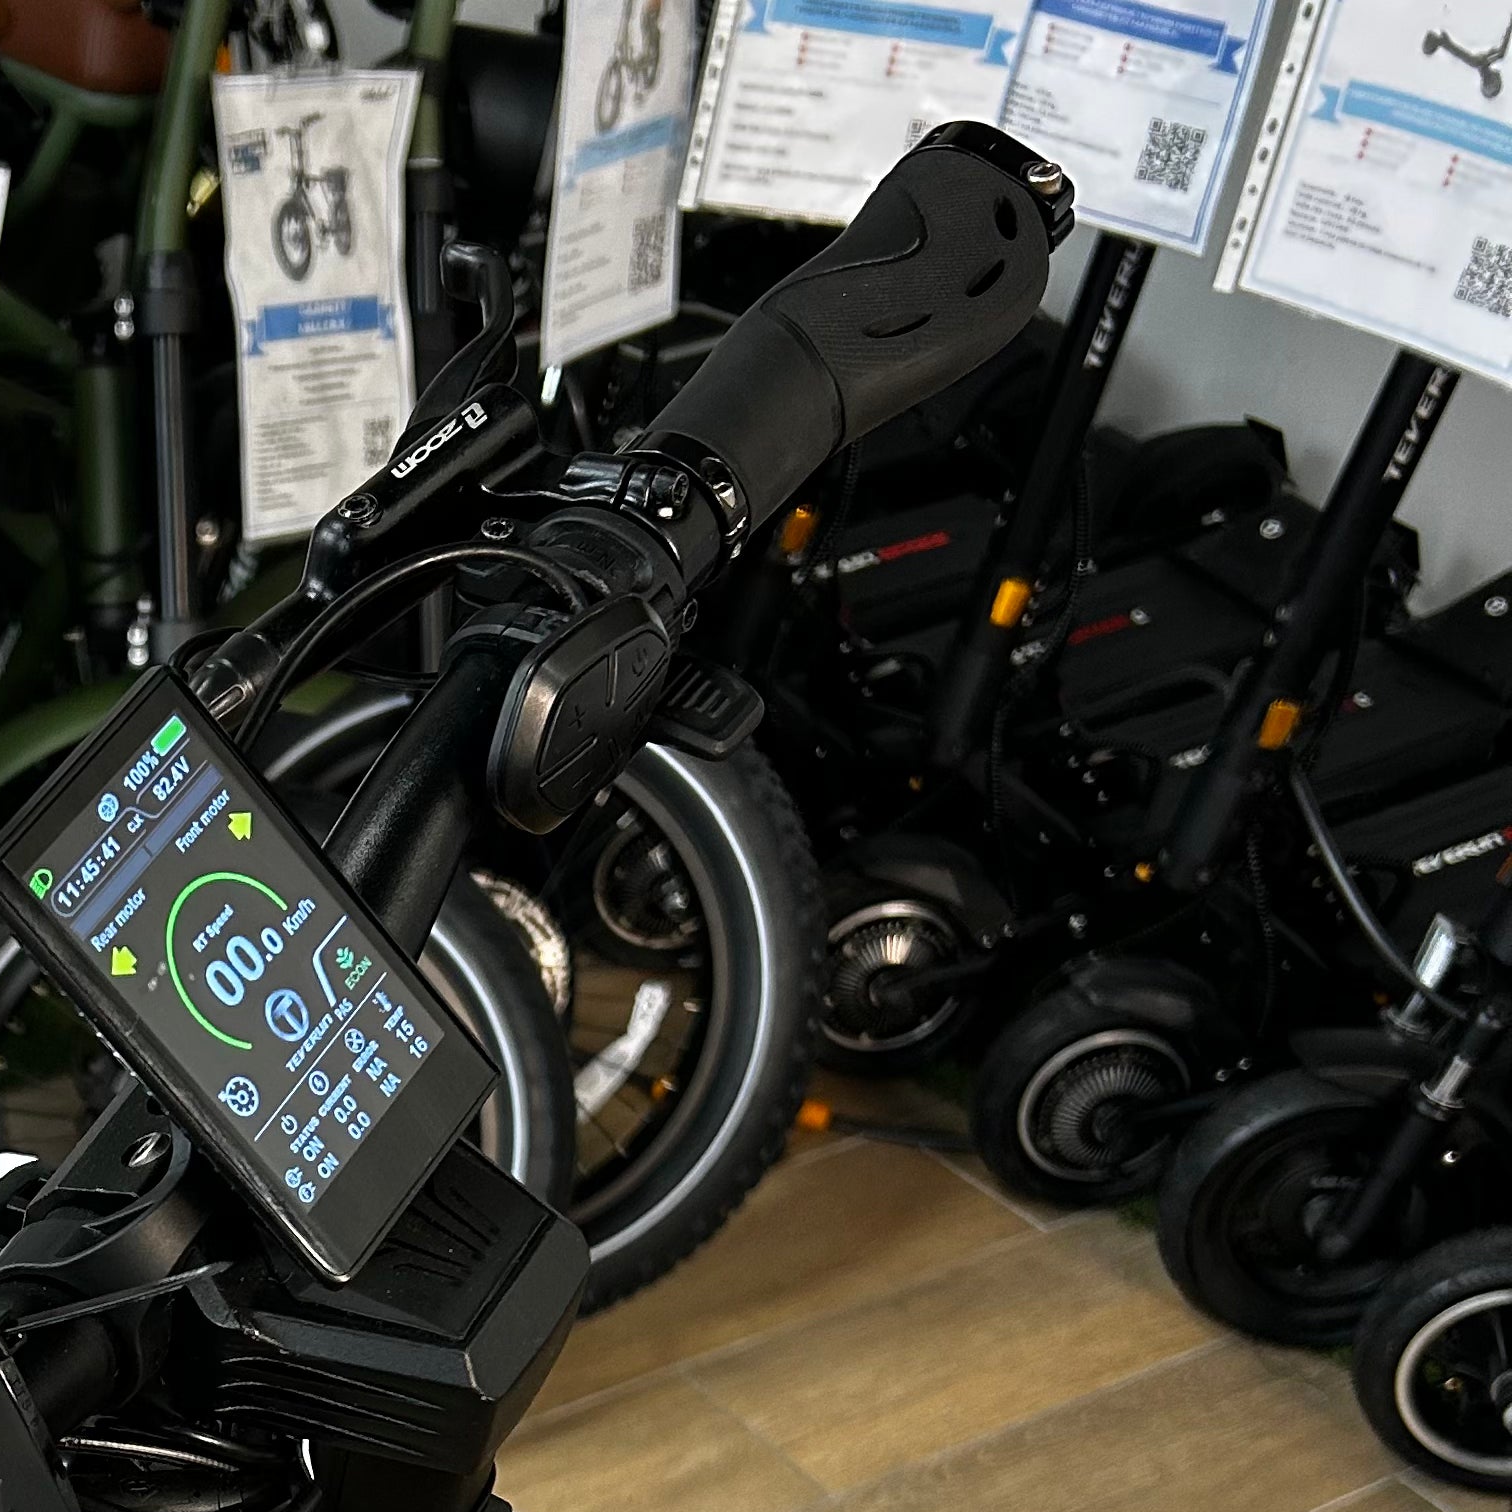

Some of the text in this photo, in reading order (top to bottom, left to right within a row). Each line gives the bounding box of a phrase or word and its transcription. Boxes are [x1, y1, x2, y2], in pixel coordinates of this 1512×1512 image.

[123, 750, 160, 792] 100%
[152, 755, 190, 802] 82.4V
[174, 789, 231, 854] Front motor
[57, 836, 122, 907] 11:45:41
[89, 887, 146, 953] Rear motor
[281, 898, 316, 936] Km/h
[344, 955, 373, 991] ECON
[333, 997, 354, 1022] PAS
[284, 1012, 334, 1073] TEVERUN
[302, 1019, 415, 1162] ON 0.0 NA 15
[317, 1035, 429, 1179] ON 0.0 NA 16
[289, 1115, 321, 1154] STATUS
